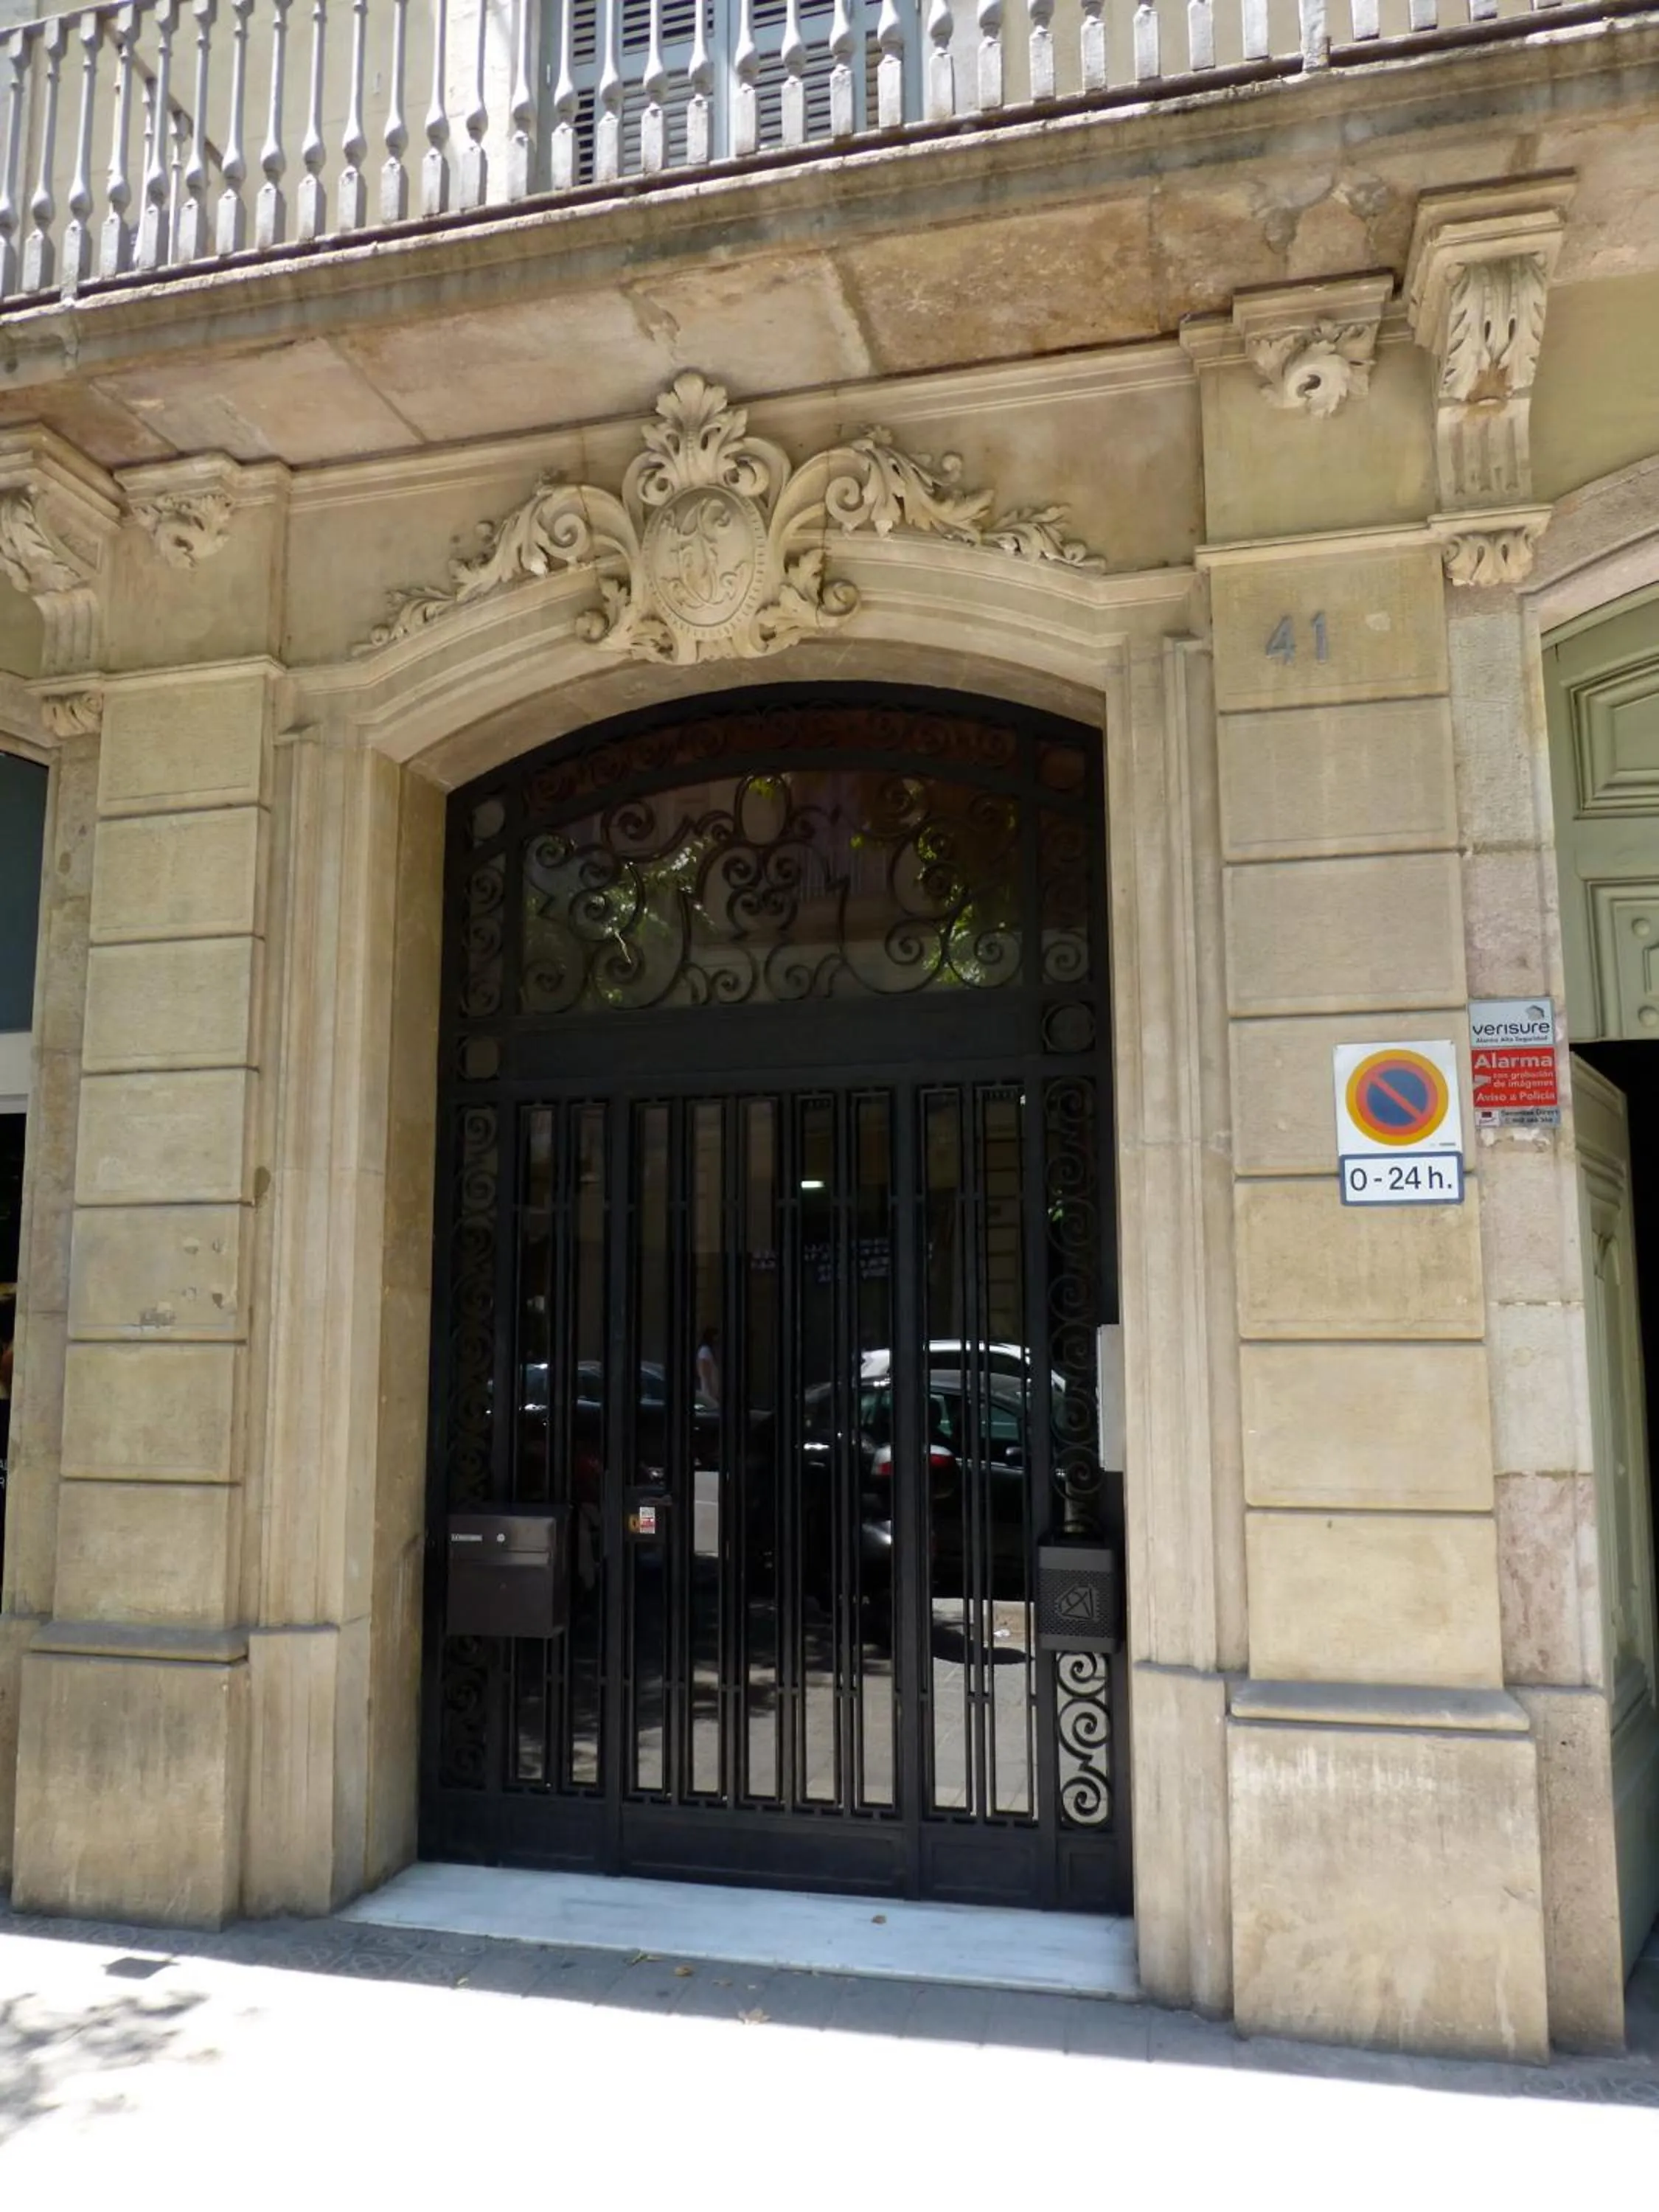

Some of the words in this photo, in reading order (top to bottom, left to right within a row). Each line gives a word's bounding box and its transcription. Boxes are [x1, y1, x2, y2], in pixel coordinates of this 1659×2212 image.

[1265, 611, 1327, 665] 41
[1472, 1022, 1550, 1036] verisure
[1475, 1052, 1553, 1069] Alarma
[1476, 1092, 1507, 1102] Aviso
